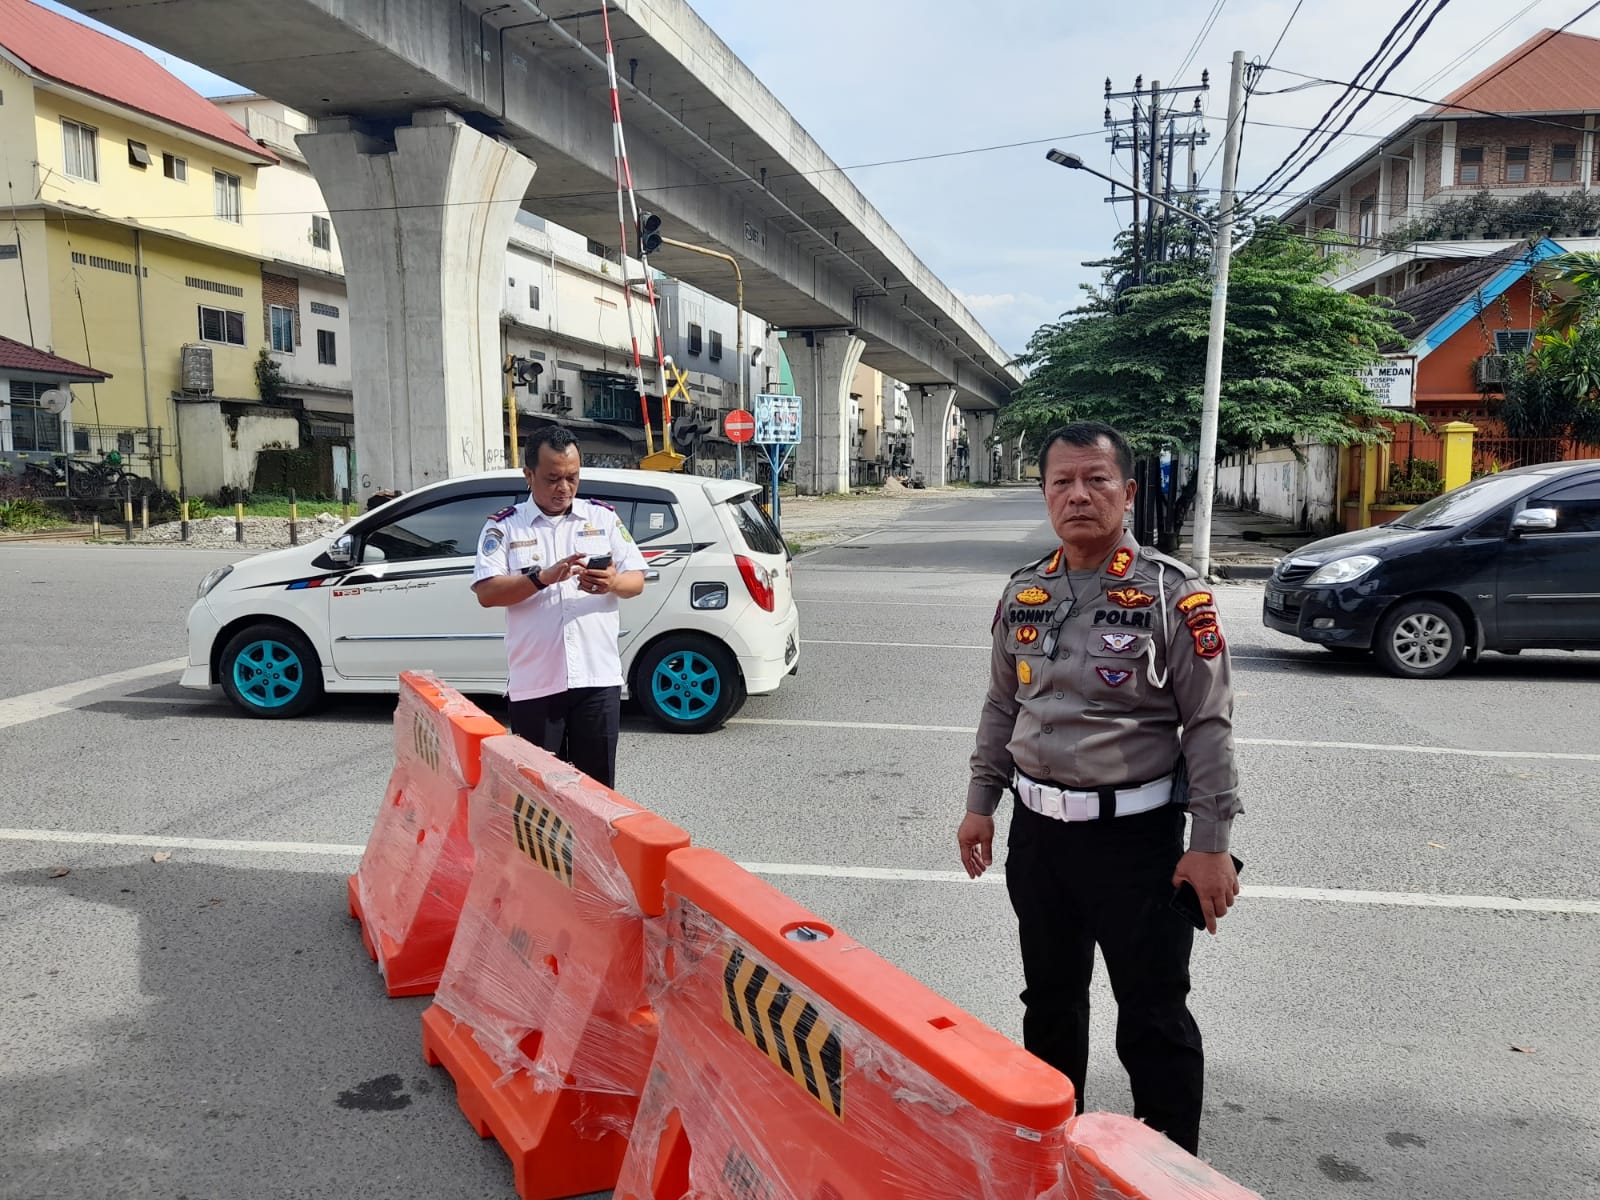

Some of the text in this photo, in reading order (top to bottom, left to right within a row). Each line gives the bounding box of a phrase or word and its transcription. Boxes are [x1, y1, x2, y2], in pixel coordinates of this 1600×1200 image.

[1379, 368, 1411, 376] MEDAN
[1009, 609, 1054, 623] SONNY
[1093, 609, 1152, 627] POLRI
